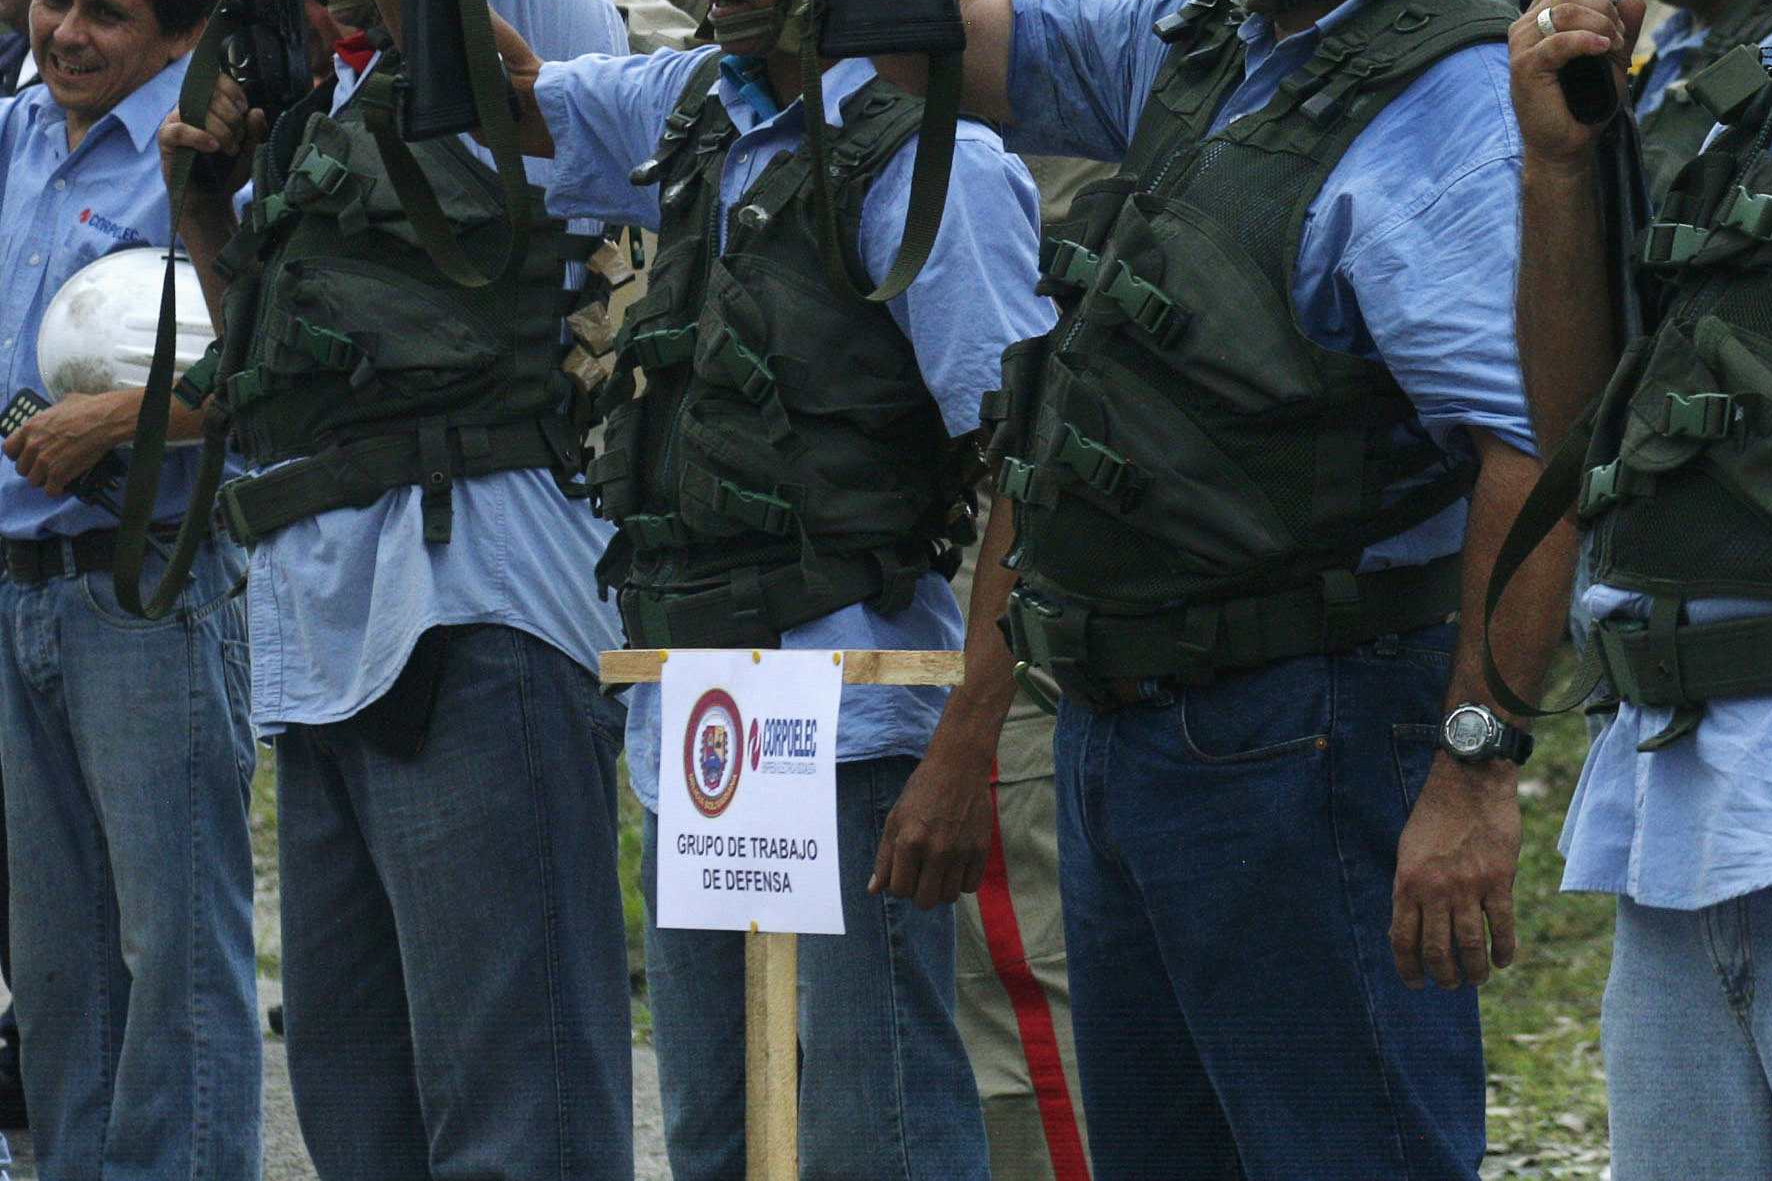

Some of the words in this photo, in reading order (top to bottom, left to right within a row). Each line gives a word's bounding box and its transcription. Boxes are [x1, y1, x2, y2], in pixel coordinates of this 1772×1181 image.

[762, 718, 817, 757] CORPOELEC
[677, 834, 724, 856] GRUPO
[728, 837, 746, 857] DE
[750, 837, 817, 860] TRABAJO
[703, 868, 721, 890] DE
[726, 870, 792, 893] DEFENSA
